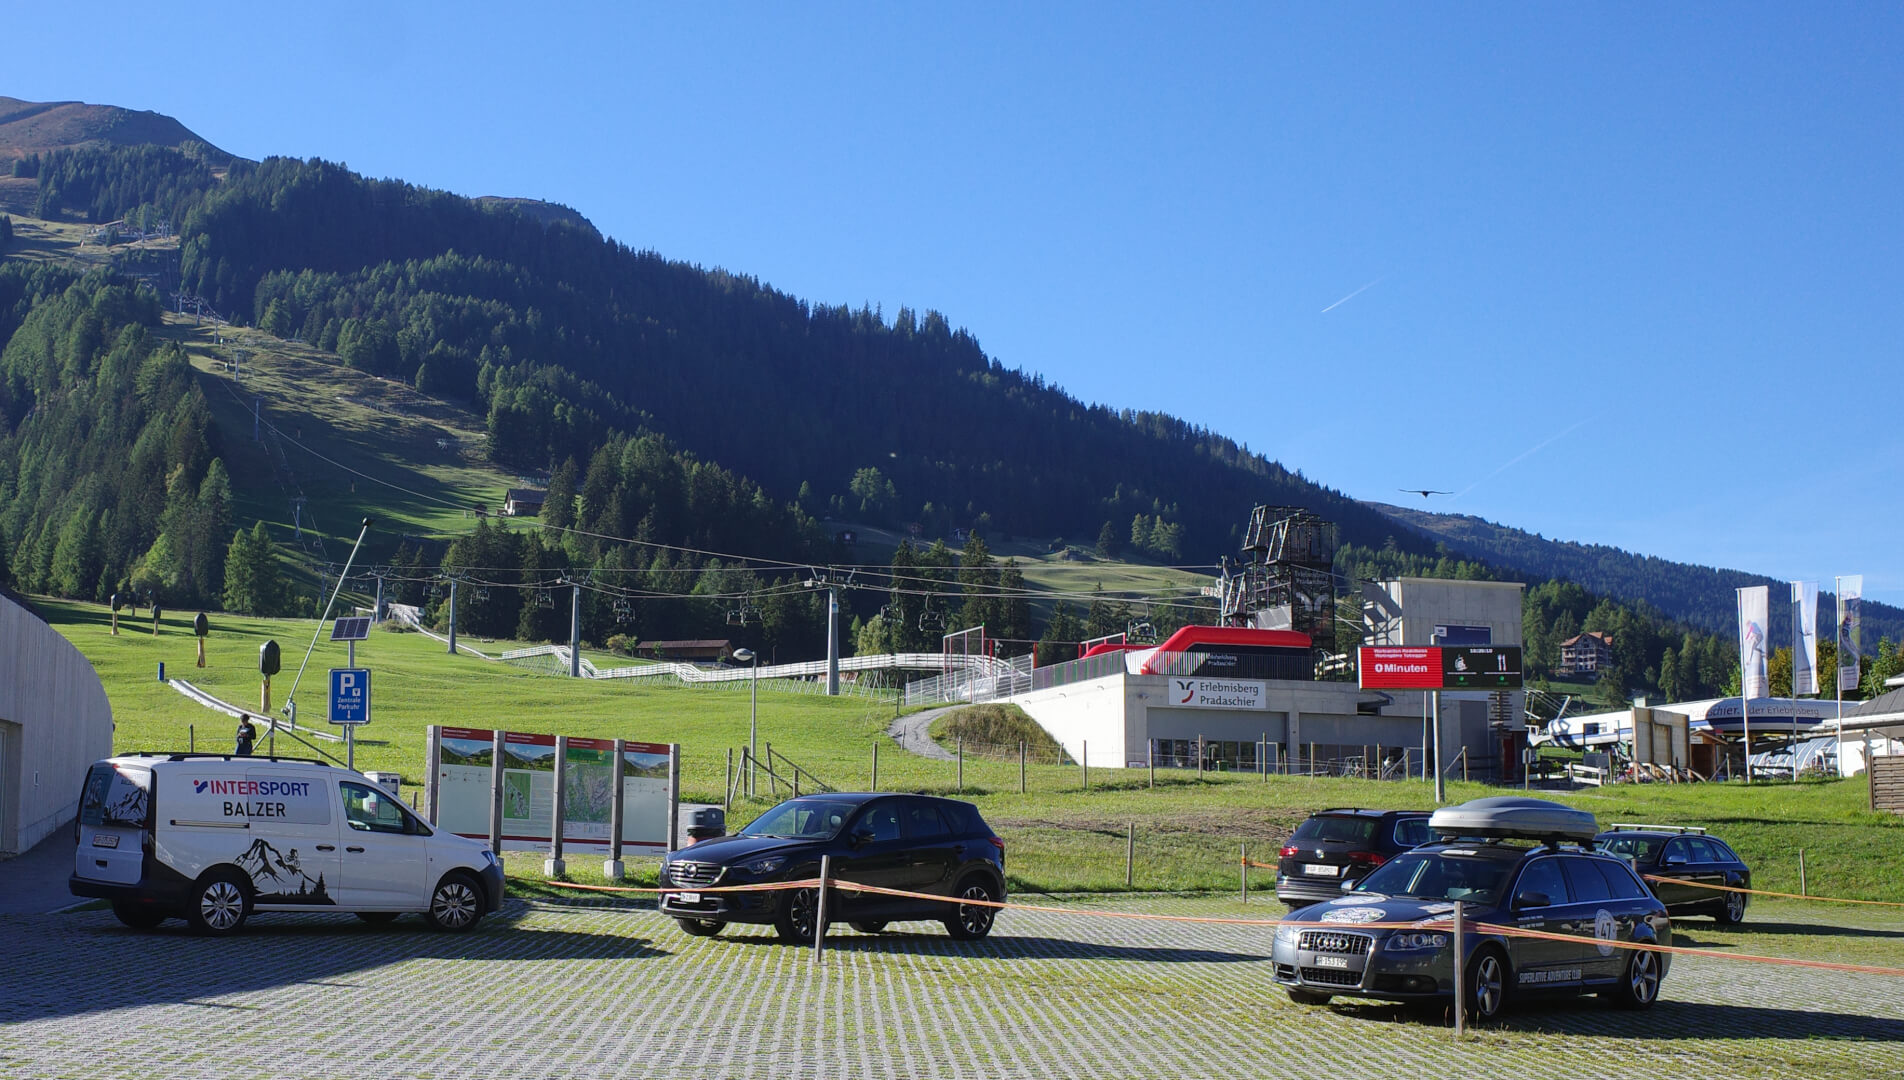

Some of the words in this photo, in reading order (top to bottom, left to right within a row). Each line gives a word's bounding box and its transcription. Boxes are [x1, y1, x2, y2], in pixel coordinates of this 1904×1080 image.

[1374, 663, 1383, 673] 0
[1384, 663, 1428, 673] Minuten
[340, 673, 355, 696] P
[1200, 682, 1259, 696] Erlebnisberg
[1200, 695, 1256, 706] Pradaschier
[210, 780, 310, 797] INTERSPORT
[223, 801, 286, 817] BALZER
[1600, 922, 1612, 941] 47
